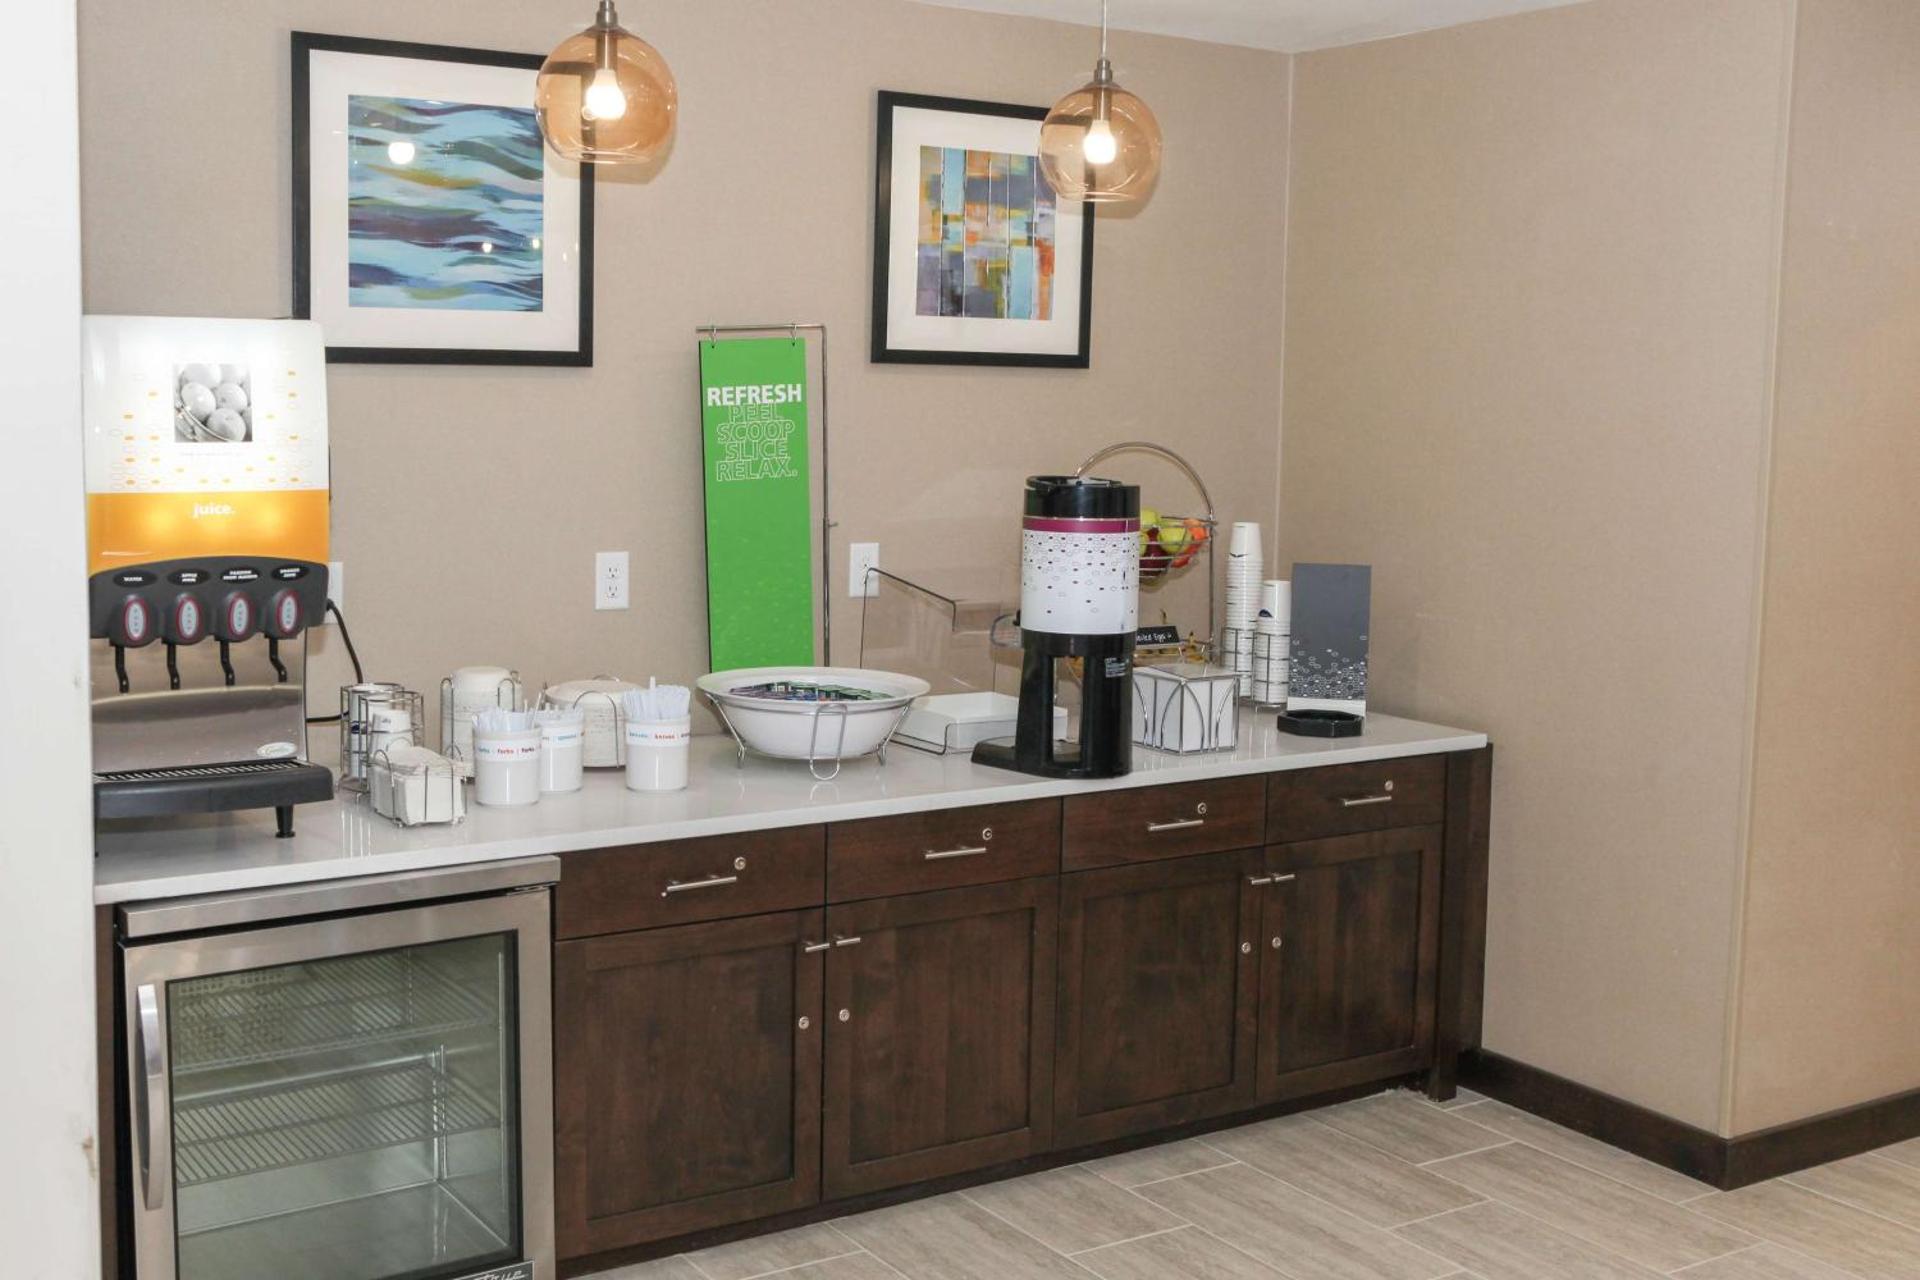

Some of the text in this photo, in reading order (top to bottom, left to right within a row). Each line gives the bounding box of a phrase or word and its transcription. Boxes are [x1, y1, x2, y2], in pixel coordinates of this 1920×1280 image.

[707, 384, 802, 406] REFRESH
[729, 403, 784, 422] PEEL
[717, 420, 795, 443] SCOOP
[725, 440, 788, 461] SLICE
[716, 457, 798, 481] RELAX.
